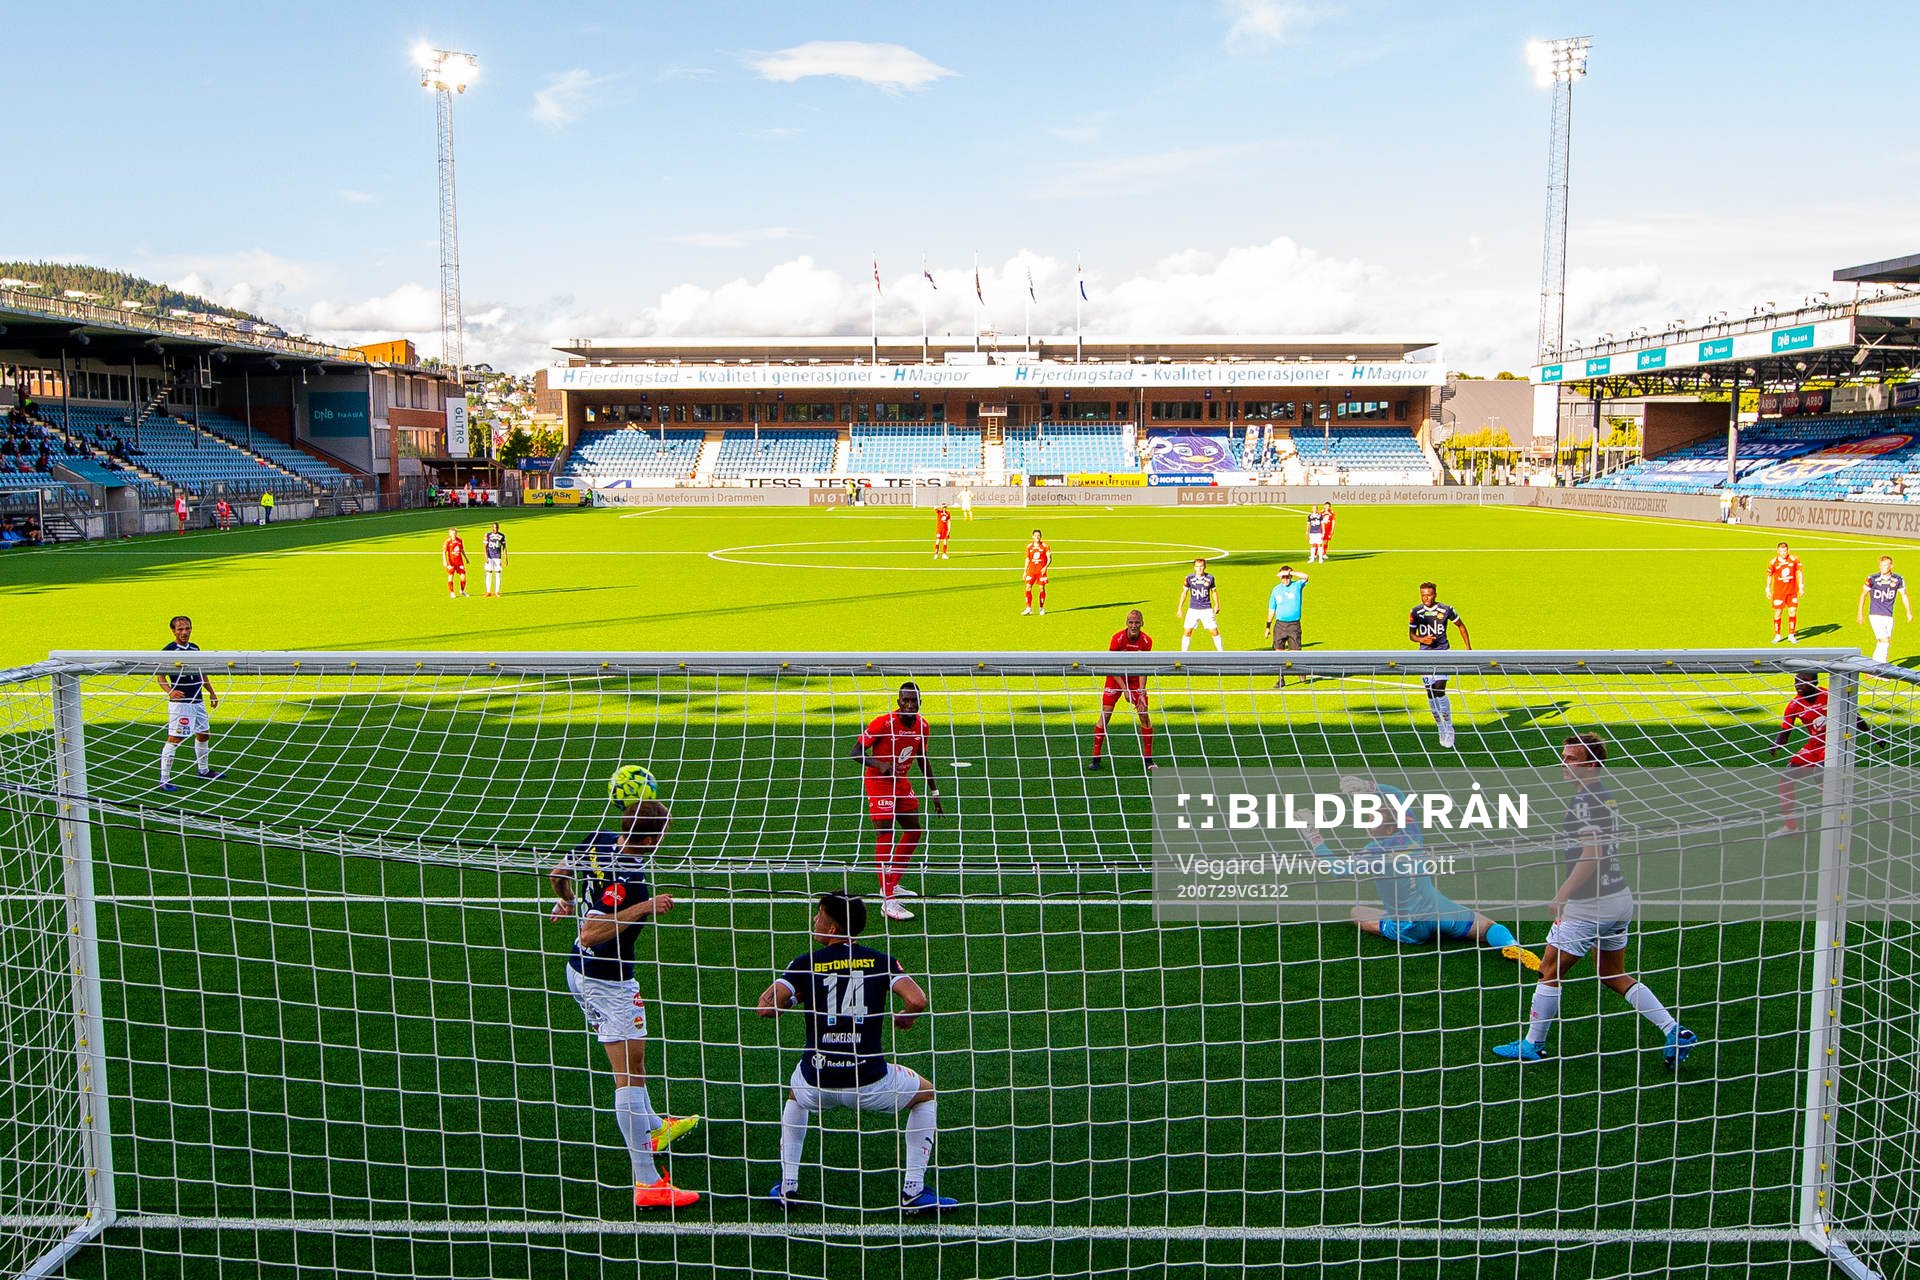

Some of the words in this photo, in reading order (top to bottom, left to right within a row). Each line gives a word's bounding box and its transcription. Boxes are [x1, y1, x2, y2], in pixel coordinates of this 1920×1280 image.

[579, 370, 679, 386] Fjerdingstad
[699, 370, 757, 383] Kvalitet
[772, 370, 872, 386] generasjoner
[909, 369, 970, 385] Magnor
[1032, 368, 1134, 384] Fjerdingstad
[1154, 367, 1212, 381] Kvalitet
[1228, 368, 1330, 384] generasjoner
[1367, 367, 1429, 383] Magnor
[1760, 398, 1777, 410] ARBO
[1782, 396, 1799, 408] ARBO
[1805, 395, 1823, 406] ARBO
[314, 408, 334, 422] DNB
[597, 493, 620, 502] Meld
[623, 493, 640, 505] deg
[642, 493, 654, 504] på
[657, 493, 709, 502] Møteforum
[717, 493, 765, 502] Drammen
[813, 493, 846, 503] MØT
[988, 491, 1006, 503] deg
[1008, 491, 1020, 504] på
[1084, 492, 1132, 501] Drammen
[1332, 491, 1356, 501] Meld
[1358, 491, 1376, 503] deg
[1379, 491, 1391, 503] på
[1393, 491, 1447, 501] Møteforum
[1456, 491, 1504, 501] Drammen
[1560, 493, 1577, 506] 100%
[1578, 494, 1612, 509] NATURLIG
[1775, 505, 1804, 525] 100%
[1808, 507, 1873, 529] NATURLIG
[1873, 587, 1895, 602] DNB
[1419, 619, 1445, 637] DNB
[823, 970, 868, 1026] 14
